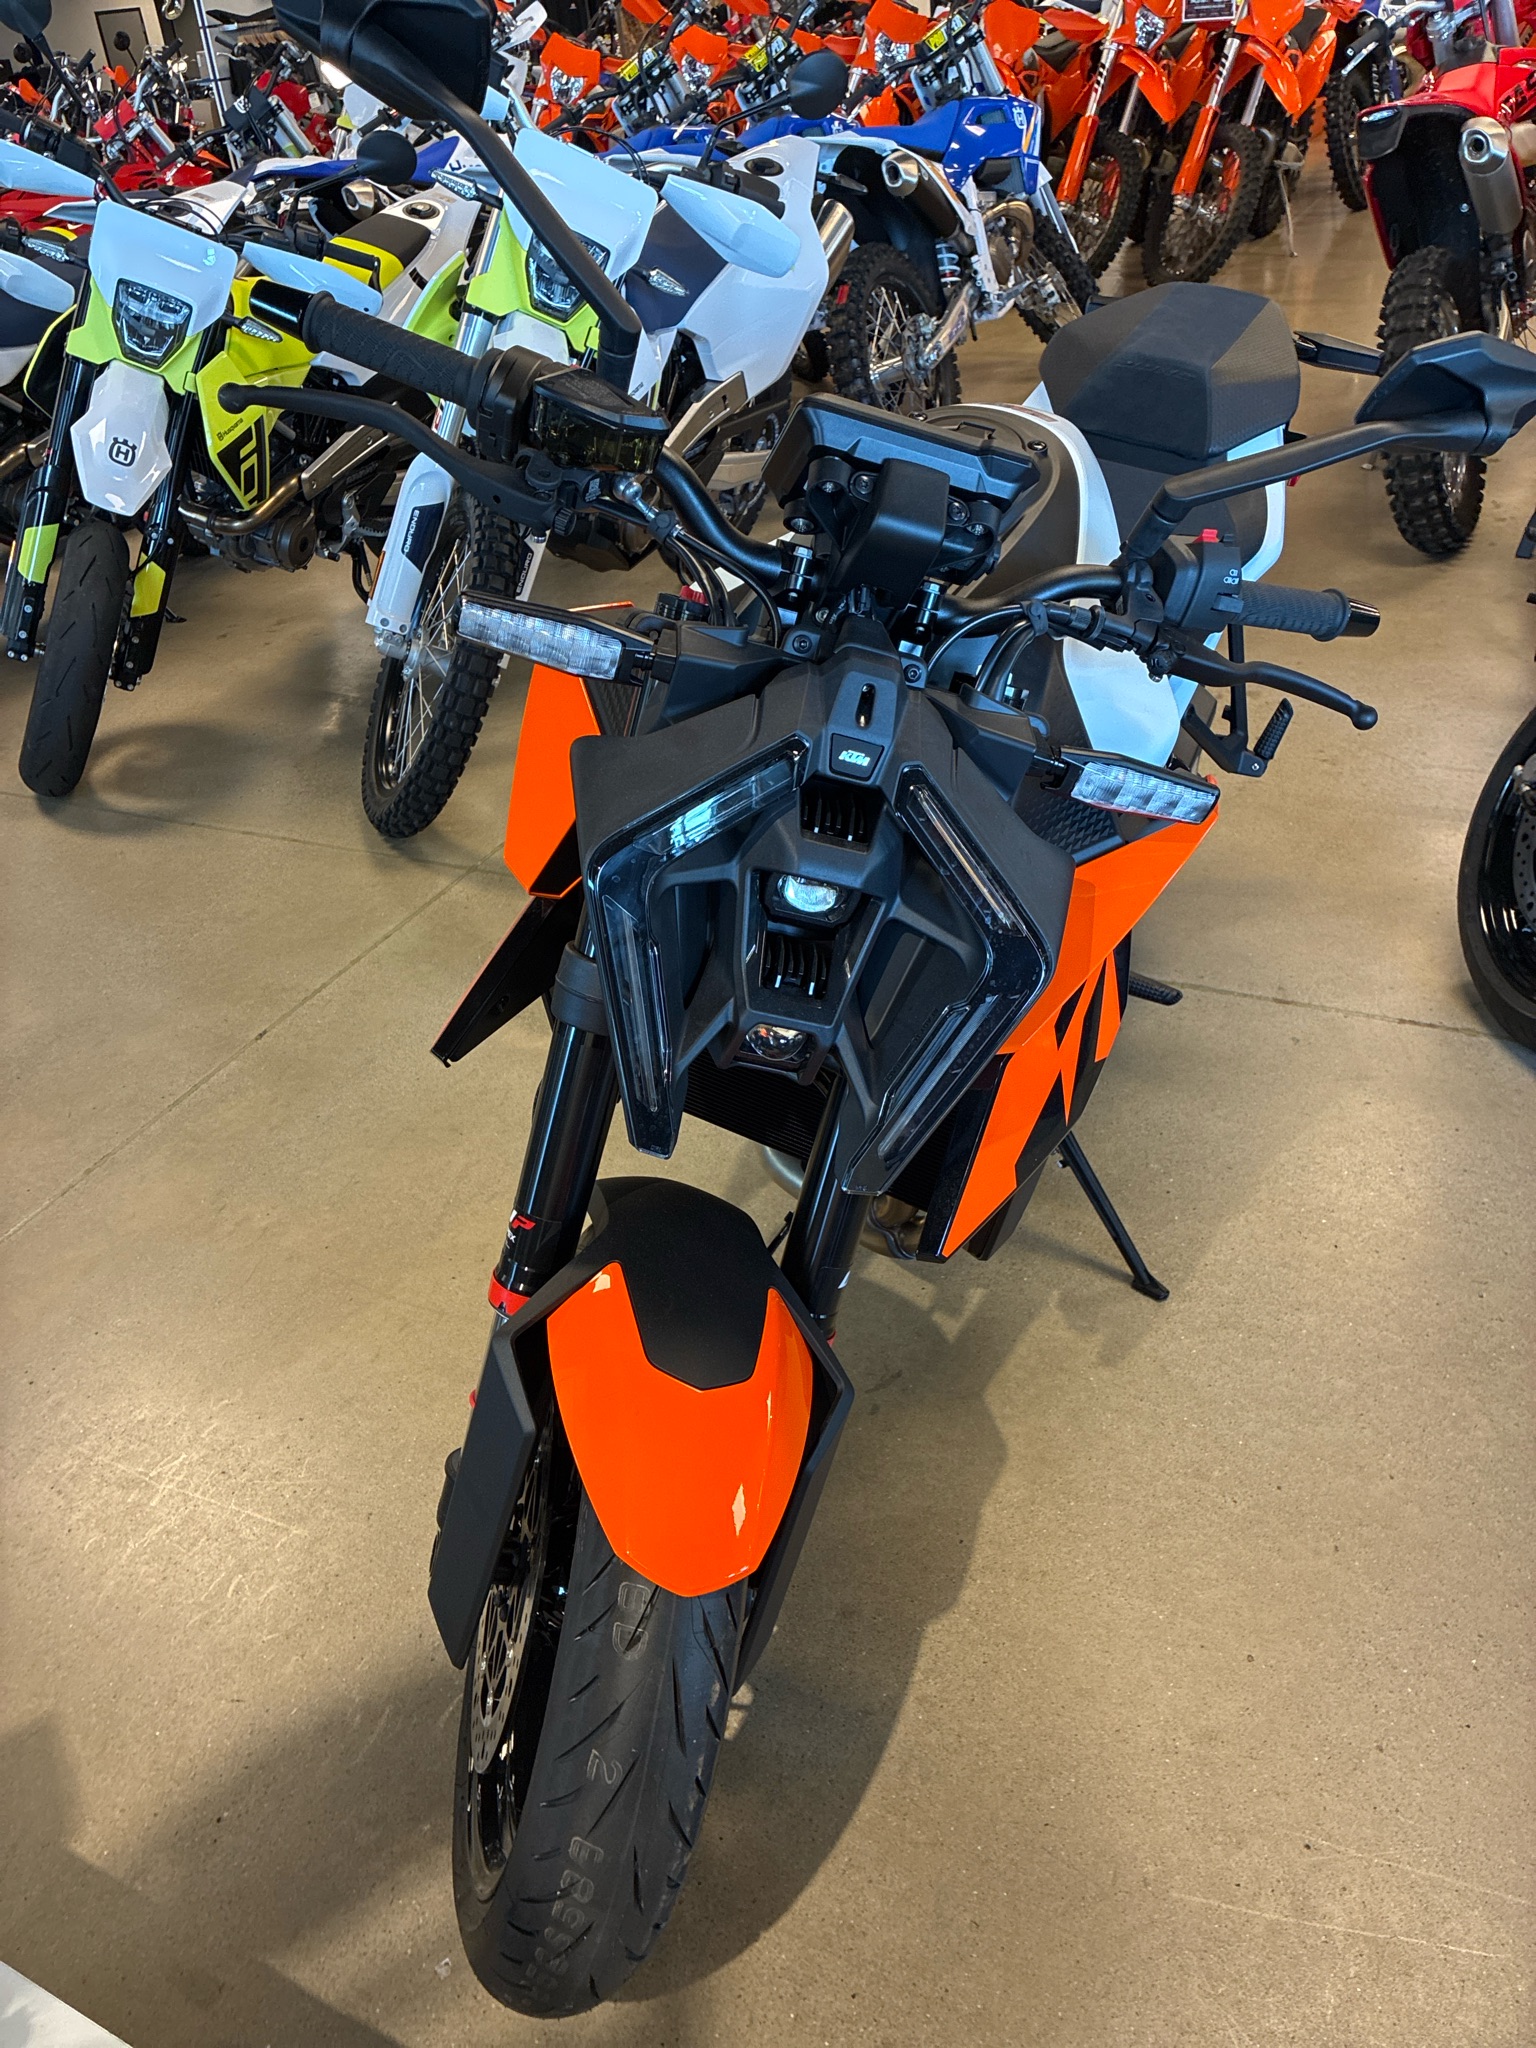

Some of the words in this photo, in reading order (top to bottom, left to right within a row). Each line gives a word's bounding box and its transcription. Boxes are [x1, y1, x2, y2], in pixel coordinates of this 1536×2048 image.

[404, 509, 420, 552] ENDURO
[516, 552, 533, 593] ENDURO
[838, 750, 871, 767] KTM
